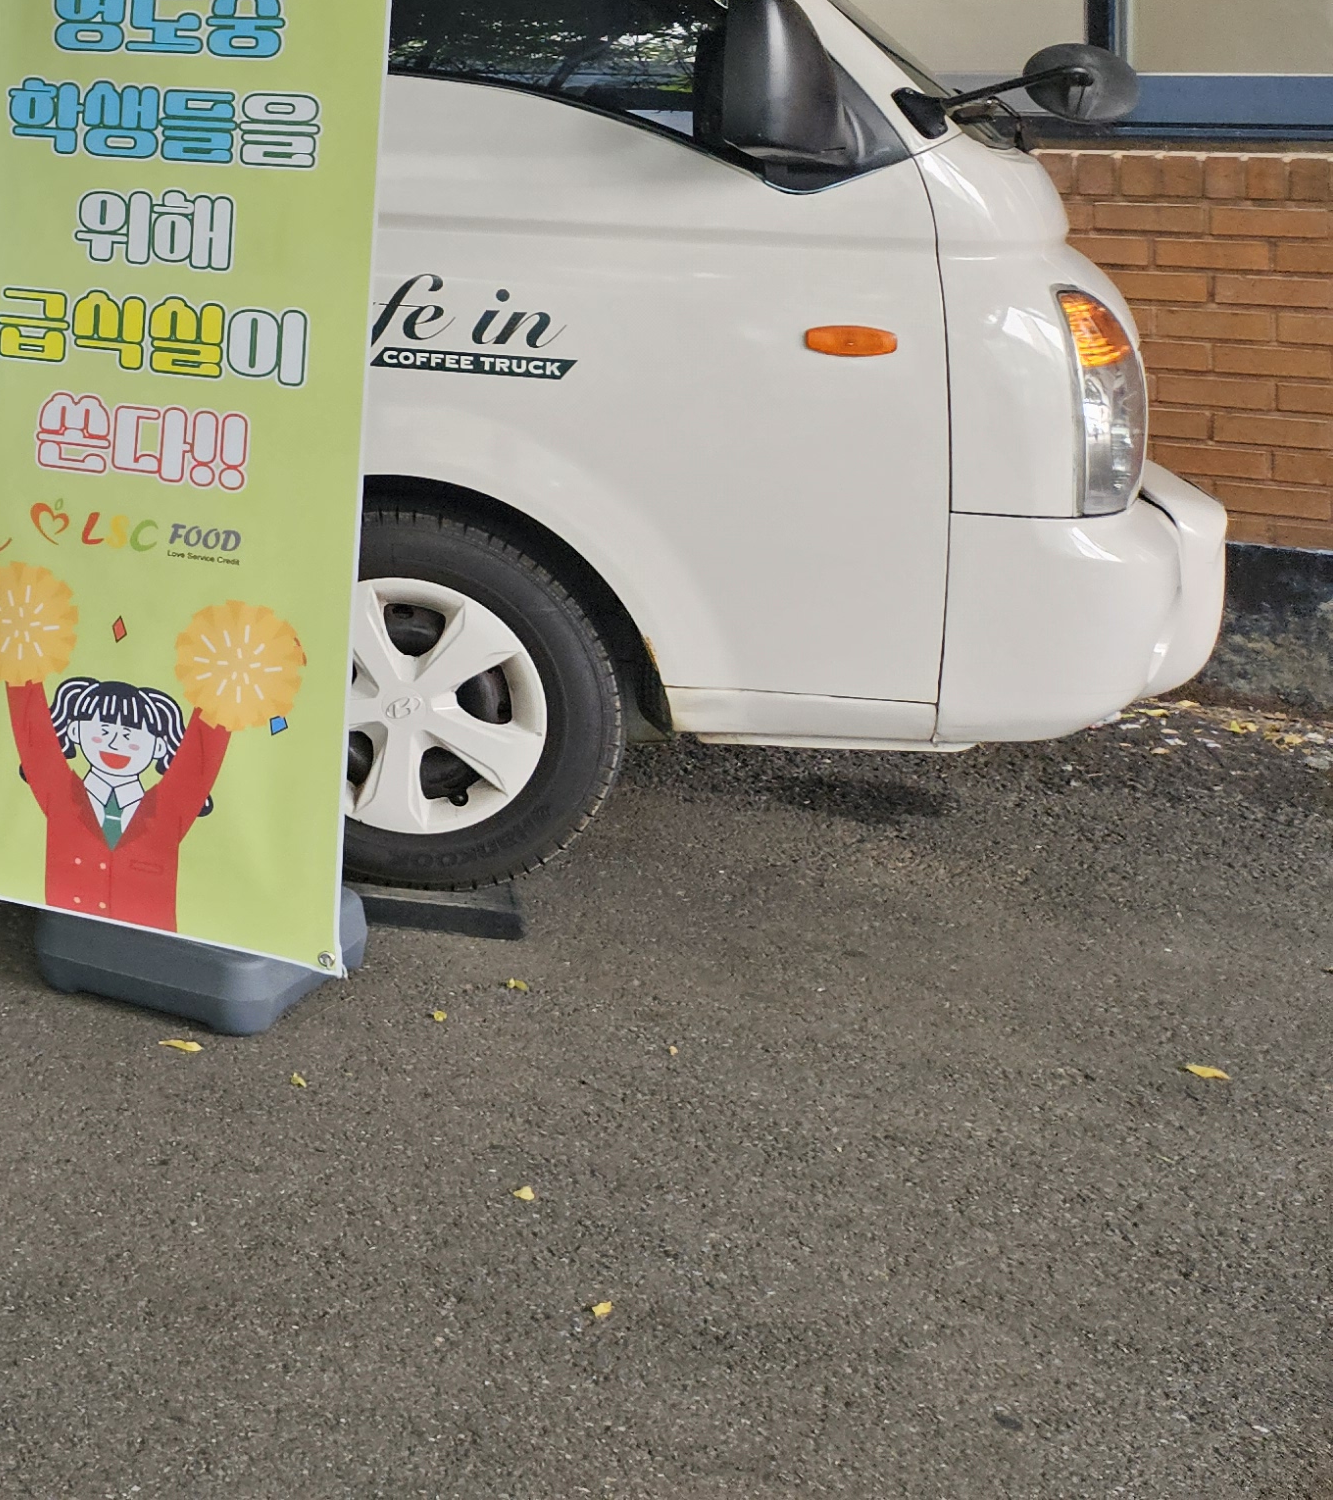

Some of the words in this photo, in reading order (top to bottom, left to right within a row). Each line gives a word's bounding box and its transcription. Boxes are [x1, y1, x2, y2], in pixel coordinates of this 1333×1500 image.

[8, 77, 321, 168] 학생들을
[75, 189, 233, 271] 위해
[472, 288, 567, 349] in
[382, 350, 474, 369] COFFEE
[480, 356, 562, 377] TRUCK
[37, 392, 249, 491] 쓴다!!
[81, 511, 159, 552] LSC
[168, 523, 242, 551] FOOD
[167, 549, 186, 559] Love
[187, 552, 216, 563] Service
[216, 556, 240, 566] Credit
